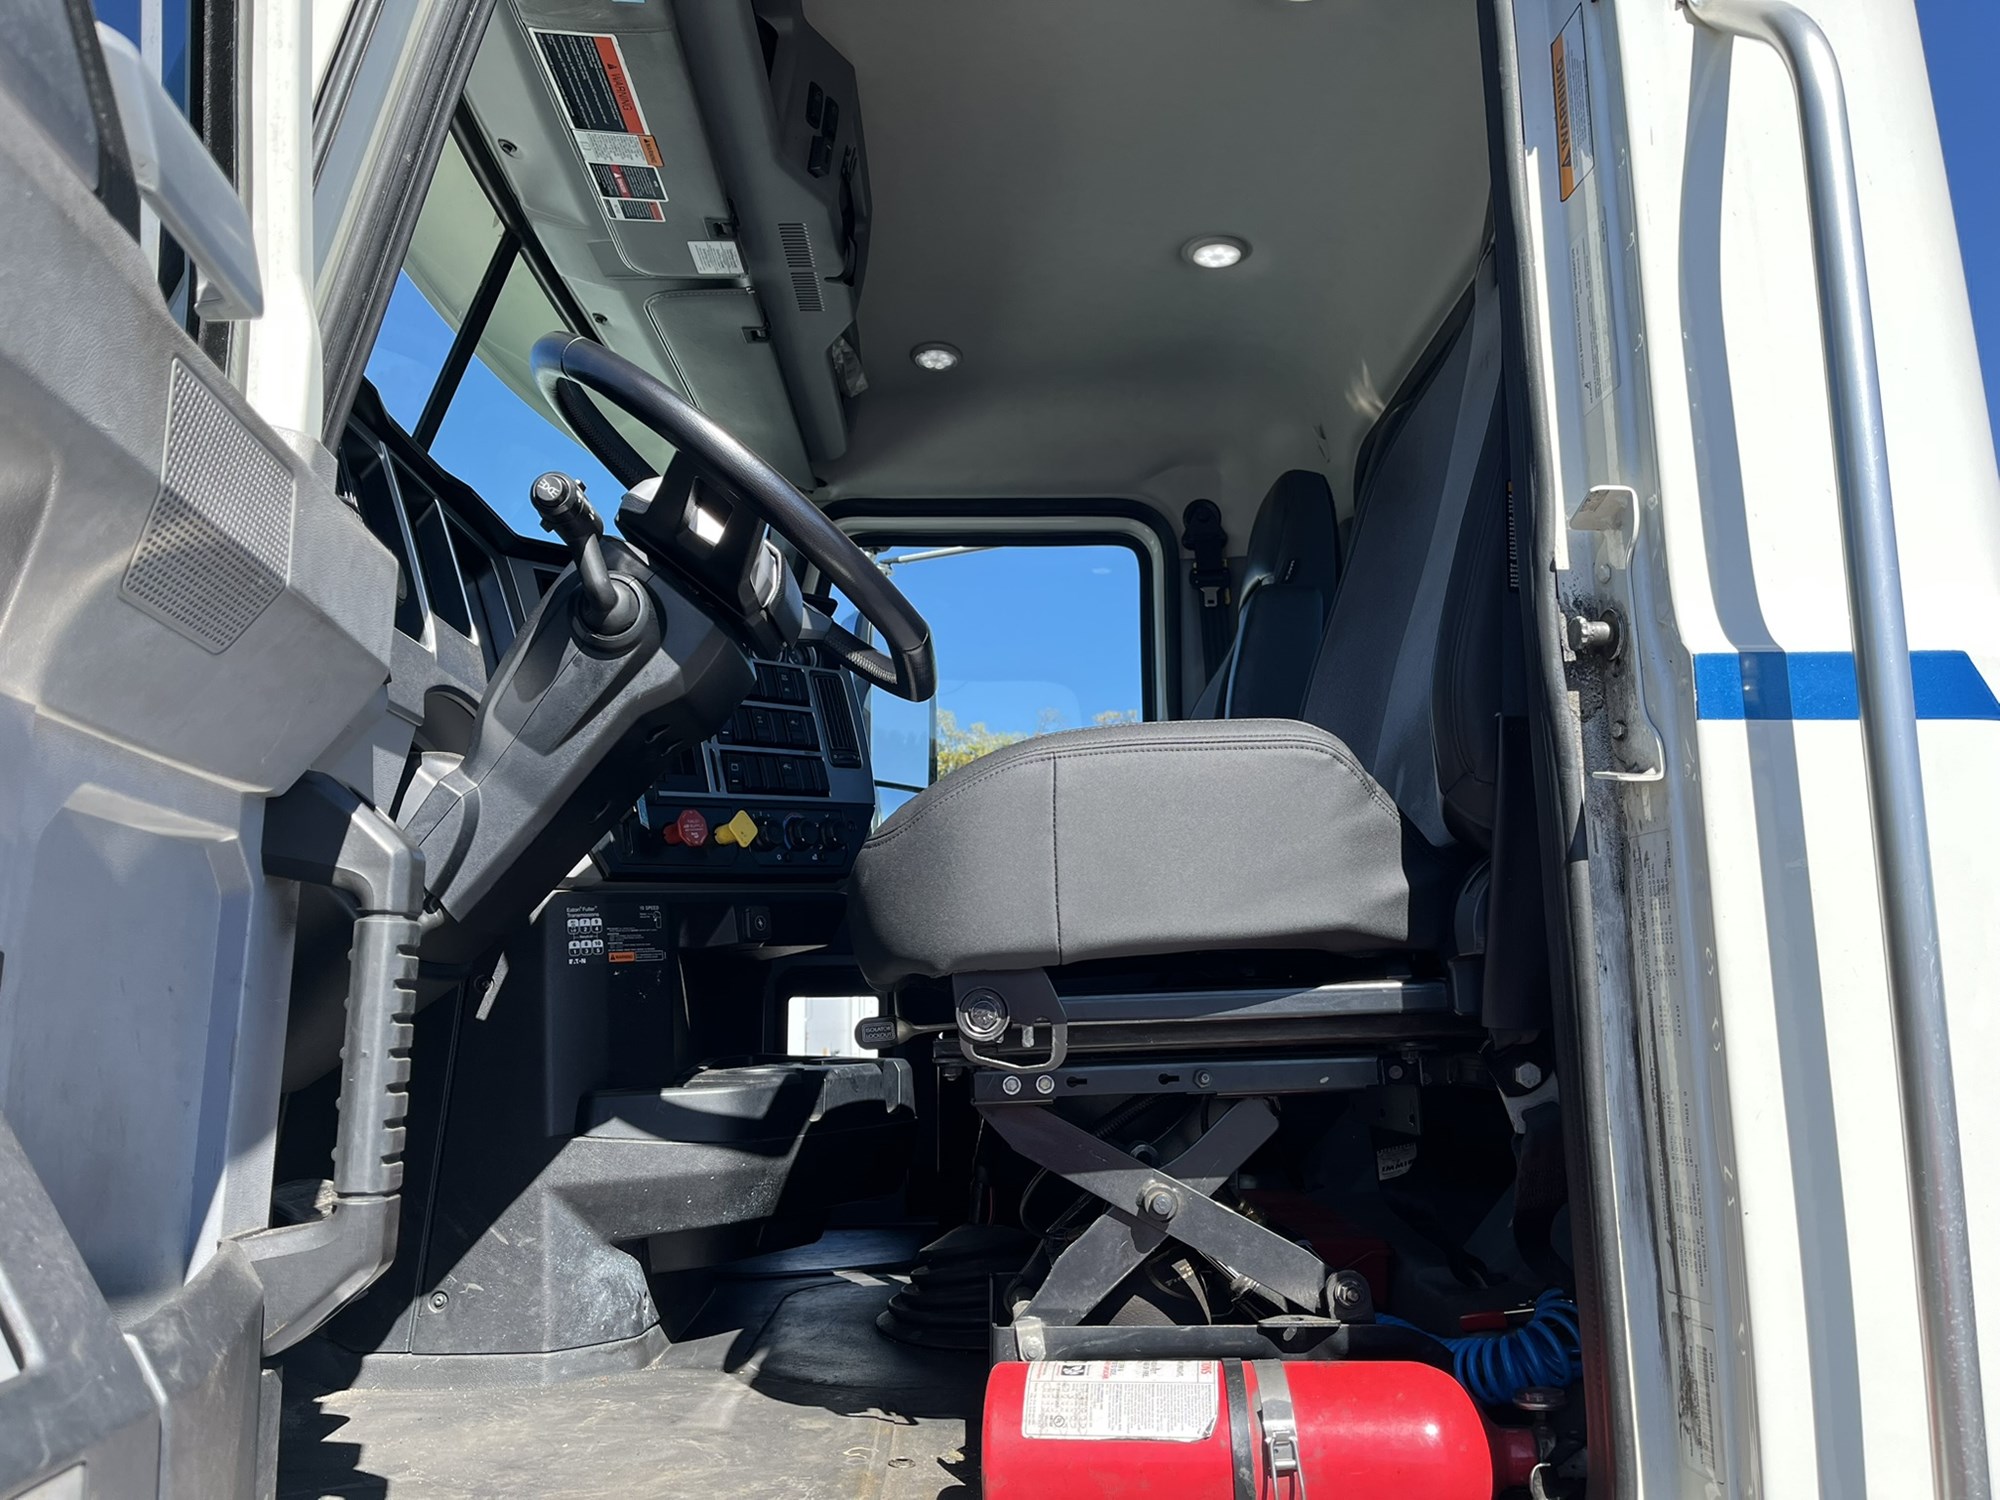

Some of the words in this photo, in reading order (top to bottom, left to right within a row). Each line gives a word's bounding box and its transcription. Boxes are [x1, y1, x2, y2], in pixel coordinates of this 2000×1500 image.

[611, 73, 632, 111] WARNING
[1556, 56, 1570, 150] WARNING
[644, 144, 657, 164] WARNING
